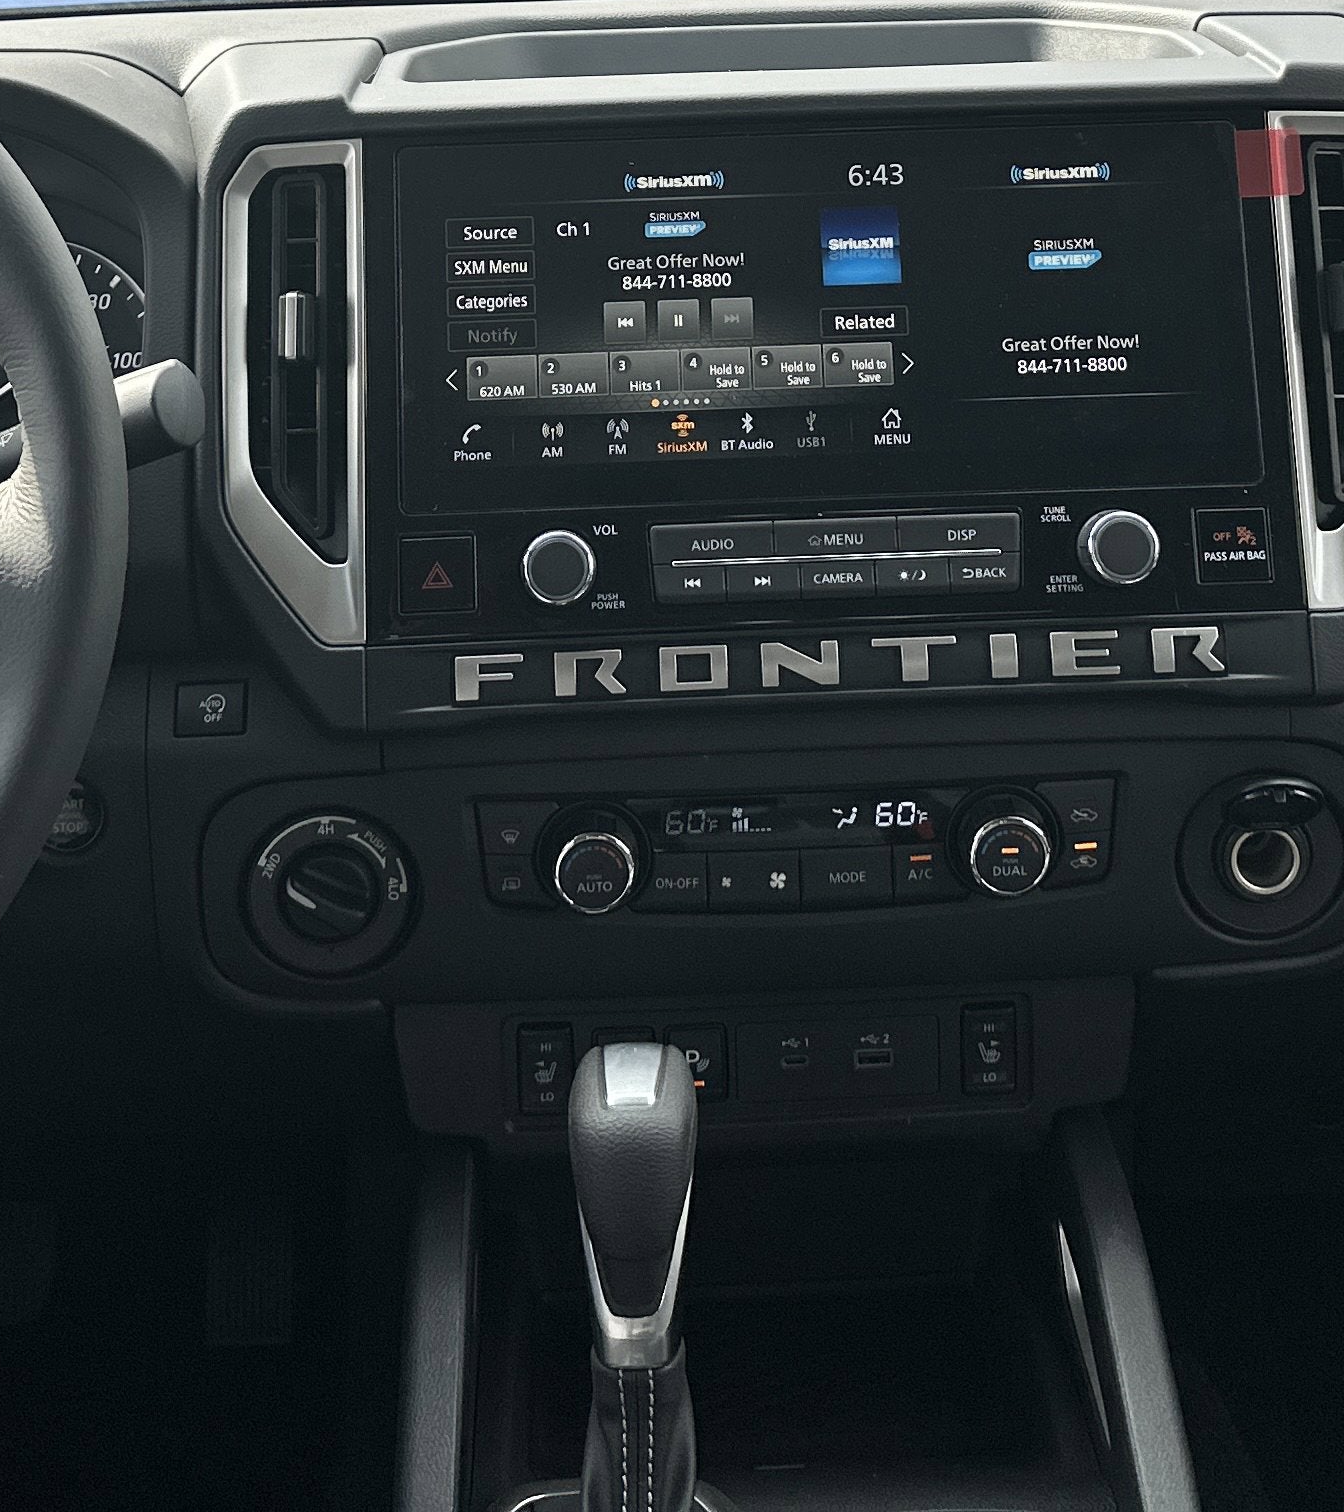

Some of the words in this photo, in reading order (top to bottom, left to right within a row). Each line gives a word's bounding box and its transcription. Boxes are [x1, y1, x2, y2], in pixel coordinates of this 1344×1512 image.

[847, 163, 905, 188] 6:43
[649, 210, 701, 222] SIRIUSXM
[463, 223, 518, 241] Source
[556, 221, 579, 237] Ch
[583, 221, 592, 236] 1
[649, 223, 701, 236] PREVIEW
[828, 236, 894, 252] SiriusXM
[1033, 238, 1095, 251] SIRIUSXM
[607, 254, 652, 271] Great
[655, 253, 700, 270] Offer
[702, 252, 746, 268] Now!
[1034, 253, 1094, 267] PREVIEW
[454, 260, 487, 276] SXM
[491, 258, 528, 275] Menu
[622, 272, 732, 291] 844-711-8800
[456, 293, 528, 312] Categories
[834, 313, 896, 331] Related
[466, 327, 518, 346] Notify
[1001, 336, 1047, 353] Great
[1050, 334, 1095, 351] Offer
[1097, 334, 1140, 349] Now!
[688, 357, 699, 369] 4
[760, 354, 769, 366] 5
[831, 352, 841, 364] 6
[475, 365, 483, 377] 1
[546, 362, 556, 375] 2
[617, 360, 627, 372] 3
[709, 363, 731, 377] Hold
[734, 365, 745, 376] to
[780, 361, 802, 374] Hold
[805, 362, 816, 373] to
[851, 358, 873, 372] Hold
[876, 360, 887, 371] to
[1017, 356, 1128, 375] 844-711-8800
[715, 376, 739, 389] Save
[787, 374, 811, 386] Save
[858, 371, 882, 384] Save
[479, 385, 500, 398] 620
[503, 384, 526, 397] AM
[551, 383, 572, 395] 530
[574, 382, 597, 394] AM
[629, 379, 652, 391] Hits
[721, 438, 741, 451] BT
[742, 437, 774, 451] Audio
[796, 435, 827, 449] USB1
[873, 433, 911, 446] MENU
[541, 446, 564, 459] AM
[608, 444, 628, 456] FM
[656, 440, 708, 454] SiriusXM
[453, 448, 492, 463] Phone
[1043, 505, 1066, 514] TUNE
[1040, 514, 1072, 523] SCROLL
[592, 524, 619, 537] VOL
[947, 529, 977, 542] DISP
[1212, 532, 1231, 542] OFF
[690, 538, 734, 552] AUDIO
[823, 533, 864, 546] MENU
[1204, 551, 1228, 562] PASS
[1229, 551, 1246, 561] AIR
[1247, 550, 1266, 560] BAG
[813, 572, 864, 585] CAMERA
[975, 567, 1007, 579] BACK
[1049, 575, 1078, 584] ENTER
[1045, 583, 1084, 594] SETTING
[596, 593, 619, 602] PUSH
[591, 599, 626, 611] POWER
[452, 624, 1230, 702] FRONTIER
[202, 712, 223, 724] OFF
[61, 798, 85, 810] ART
[316, 823, 335, 836] 4H
[363, 830, 388, 854] PUSH
[262, 852, 283, 880] 2WD
[992, 865, 1029, 876] DUAL
[829, 871, 867, 884] MODE
[908, 868, 934, 881] A/C
[387, 876, 399, 902] 4LO
[576, 881, 613, 893] AUTO
[983, 1022, 995, 1033] HI
[540, 1042, 552, 1052] HI
[983, 1072, 997, 1083] LO
[540, 1091, 555, 1102] LO
